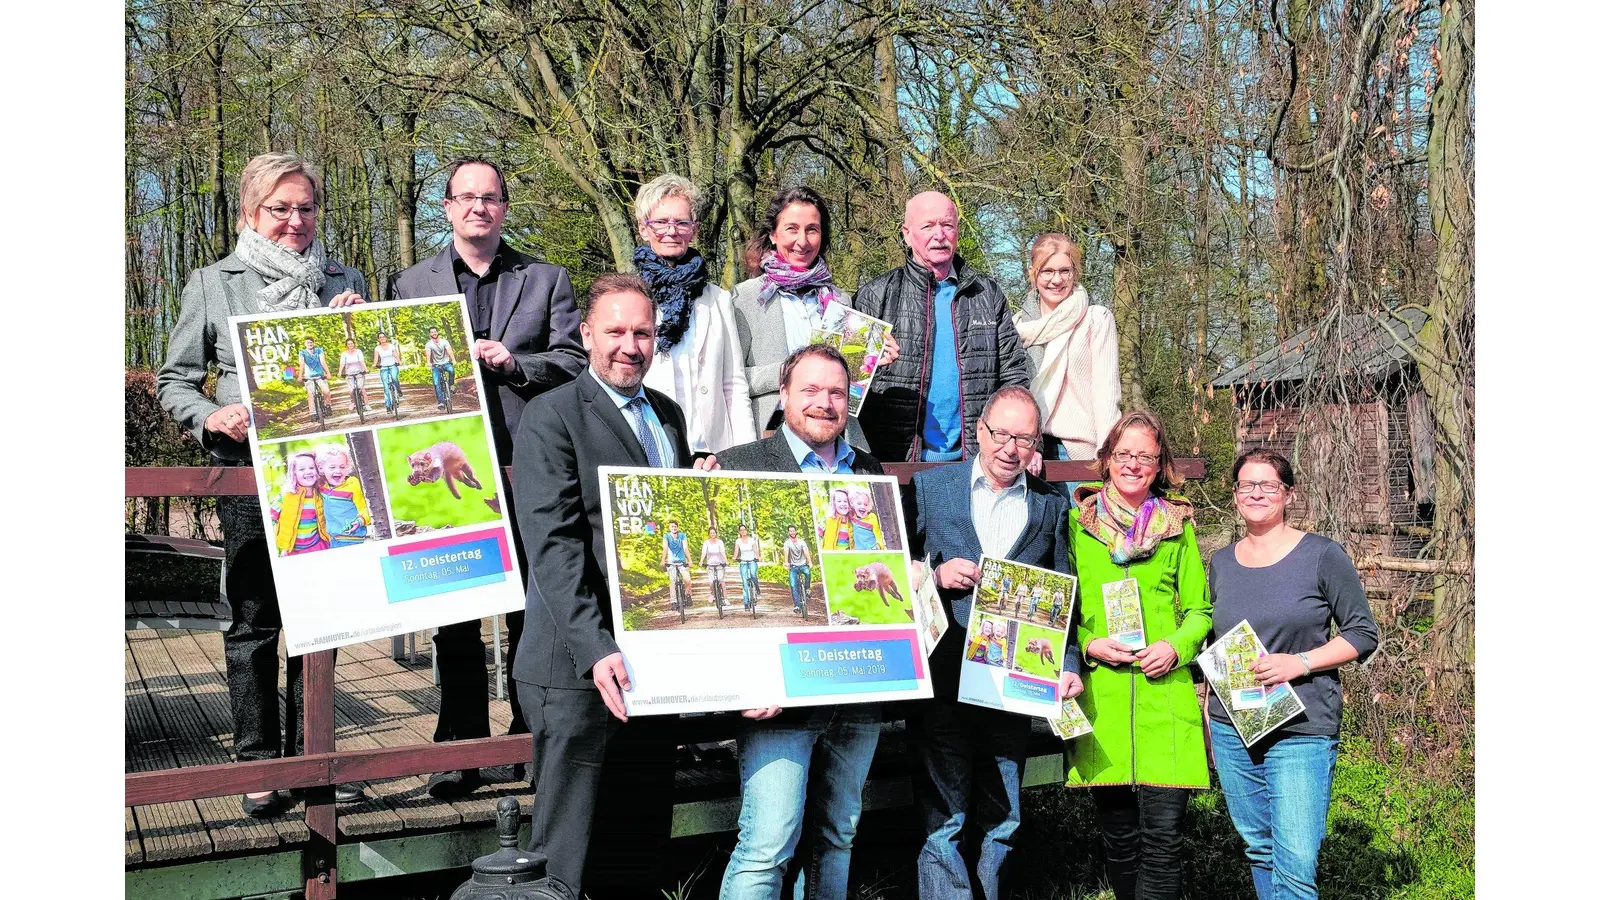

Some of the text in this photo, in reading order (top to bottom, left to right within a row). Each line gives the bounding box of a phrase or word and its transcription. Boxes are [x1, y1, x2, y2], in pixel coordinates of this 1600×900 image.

[252, 364, 281, 384] ER
[619, 516, 643, 534] ER
[401, 548, 483, 571] 12. Deistertag
[456, 564, 470, 574] Mai
[797, 648, 883, 662] 12. Deistertag
[852, 665, 866, 675] Mai
[867, 664, 887, 675] 2019
